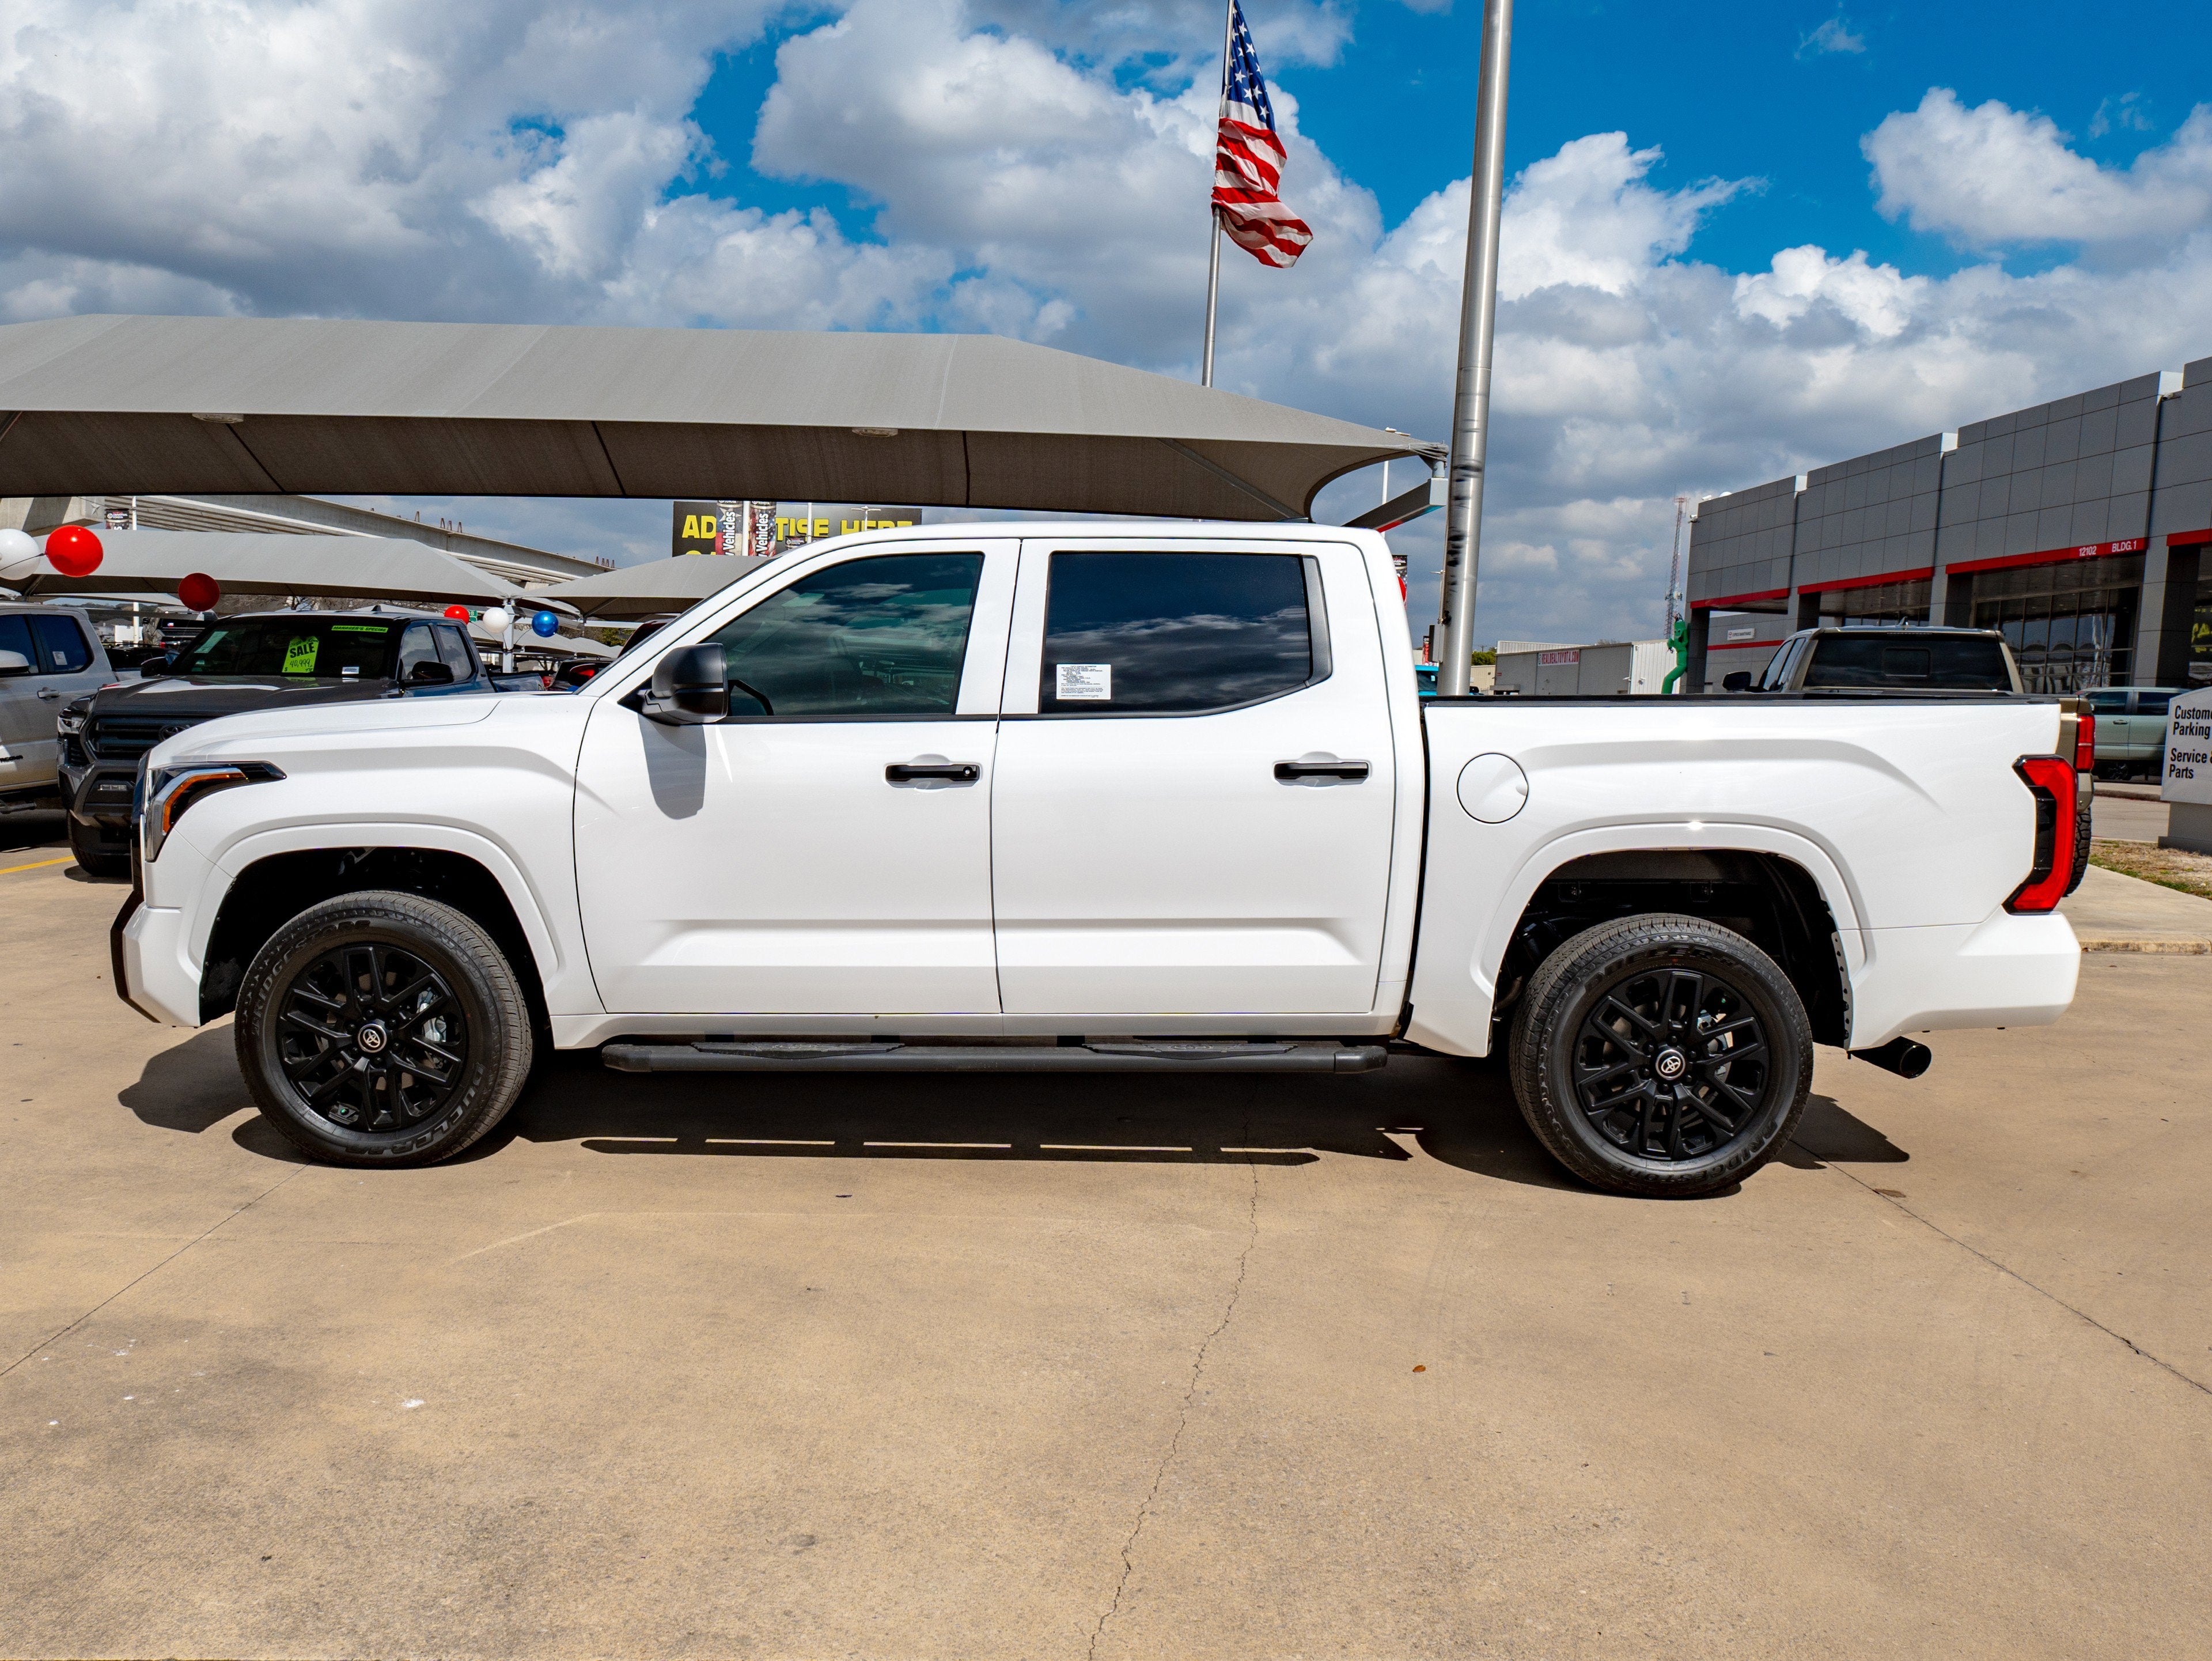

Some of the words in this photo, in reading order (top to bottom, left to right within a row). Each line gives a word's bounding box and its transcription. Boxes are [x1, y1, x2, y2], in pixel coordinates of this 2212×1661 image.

[722, 511, 736, 551] Vehicles
[756, 513, 769, 552] Vehicles
[2079, 546, 2097, 557] 12102
[290, 642, 316, 658] SALE
[2172, 721, 2210, 740] Parking
[2170, 748, 2207, 763] Service
[2169, 765, 2194, 778] Parts
[1610, 1119, 1778, 1182] BRIDGESTONE
